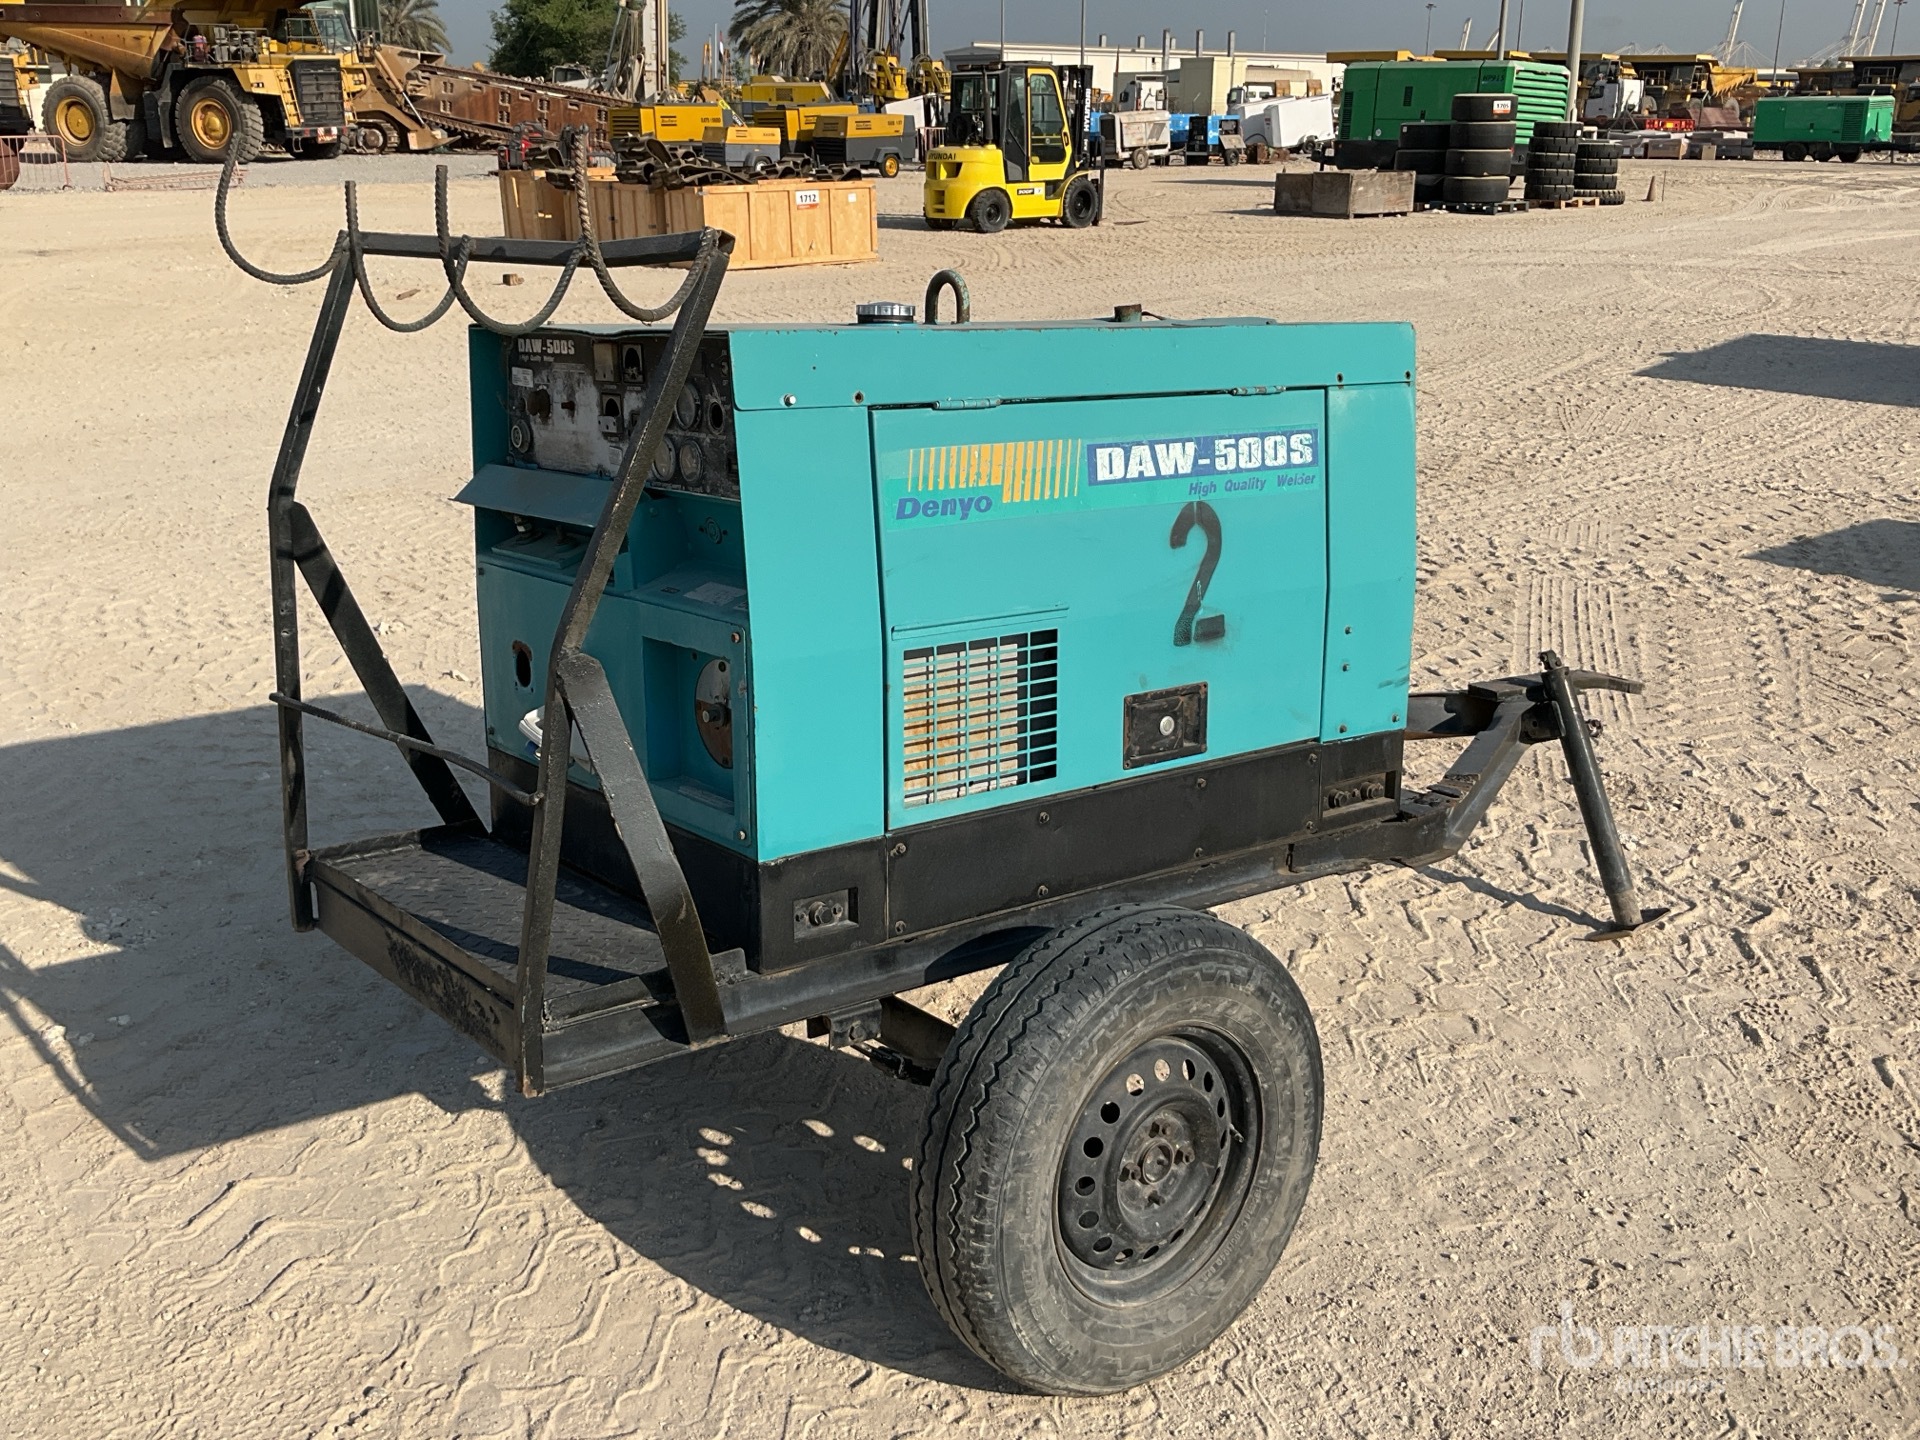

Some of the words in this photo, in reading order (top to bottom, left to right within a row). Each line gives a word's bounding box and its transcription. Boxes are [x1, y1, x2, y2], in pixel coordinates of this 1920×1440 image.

[1083, 88, 1092, 132] HYUNDAI
[799, 194, 817, 203] 1712
[518, 338, 575, 354] DAW-500S
[1095, 433, 1313, 481] DAW-500S
[1188, 481, 1217, 496] High
[1224, 477, 1267, 492] Quality
[896, 496, 993, 520] Denyo
[1170, 501, 1225, 647] 2
